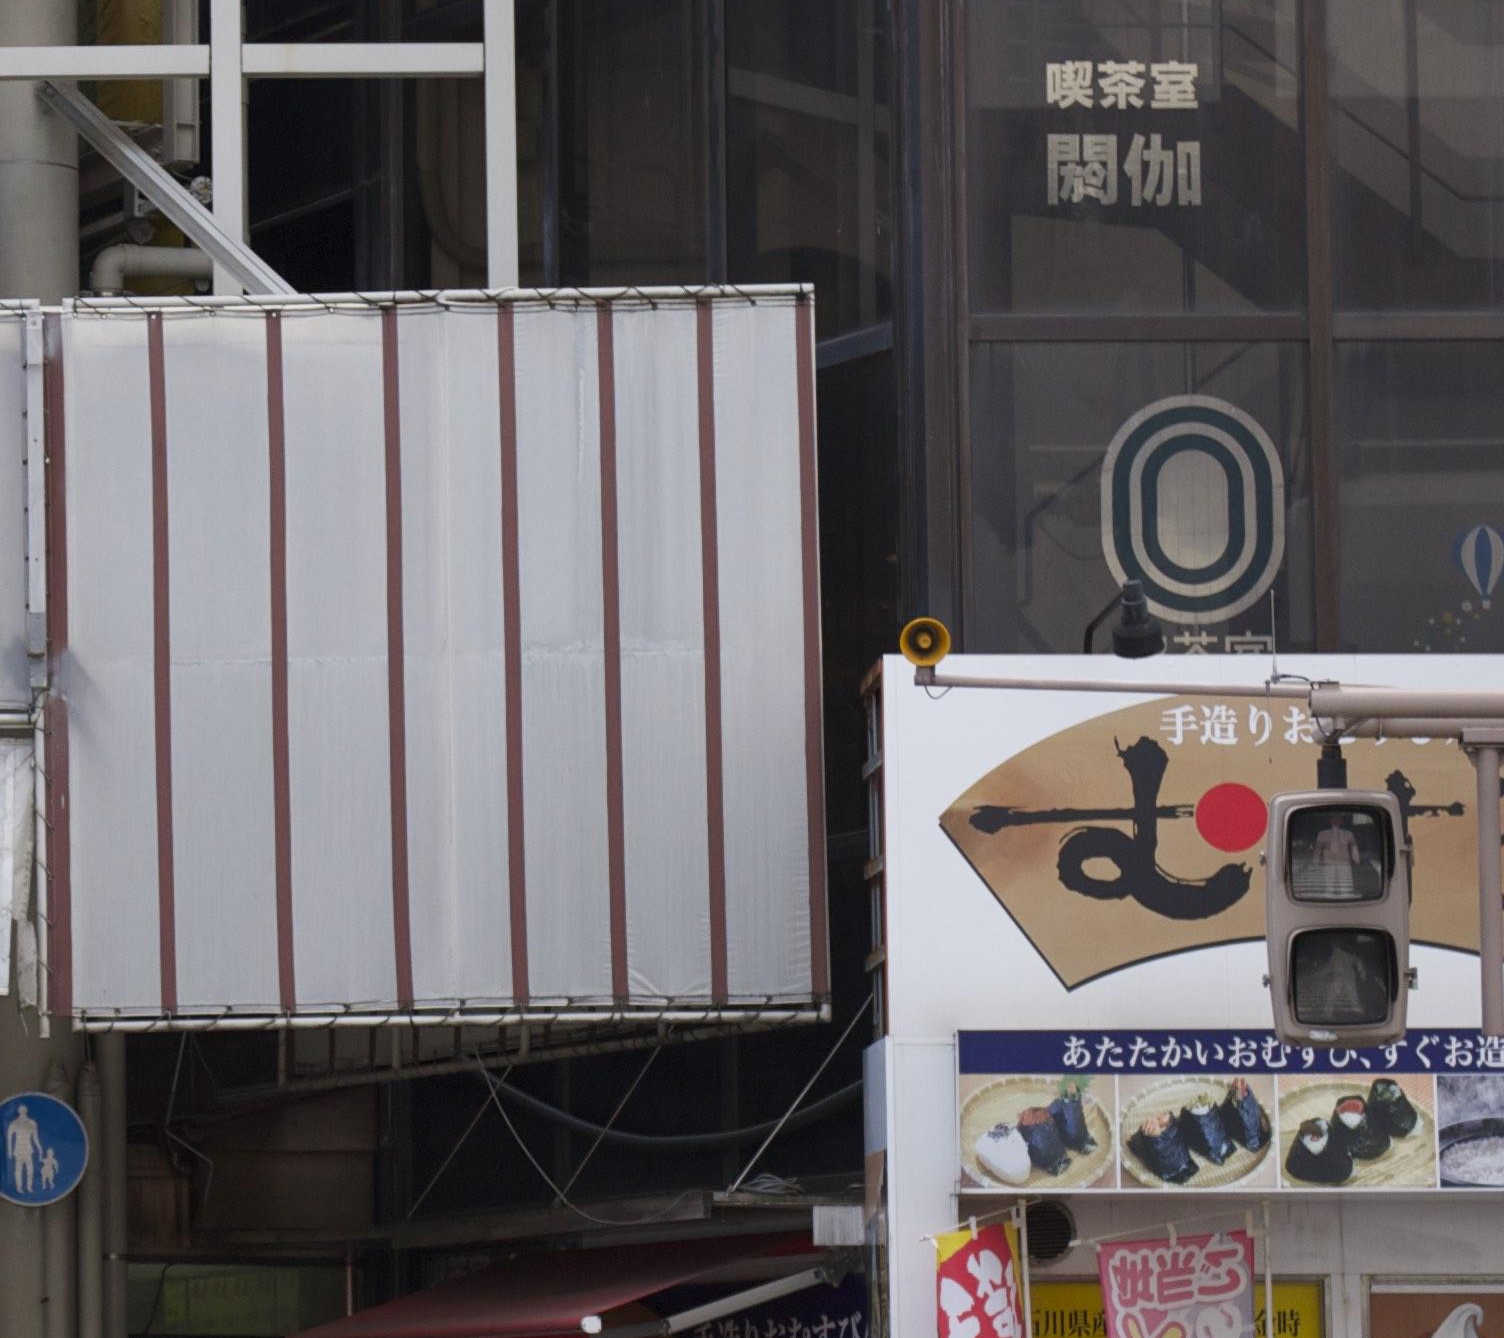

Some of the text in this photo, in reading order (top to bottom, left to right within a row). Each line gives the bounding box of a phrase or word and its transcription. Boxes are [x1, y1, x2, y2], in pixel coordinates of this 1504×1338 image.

[1045, 61, 1199, 111] 喫茶室
[1046, 133, 1203, 208] 閼伽
